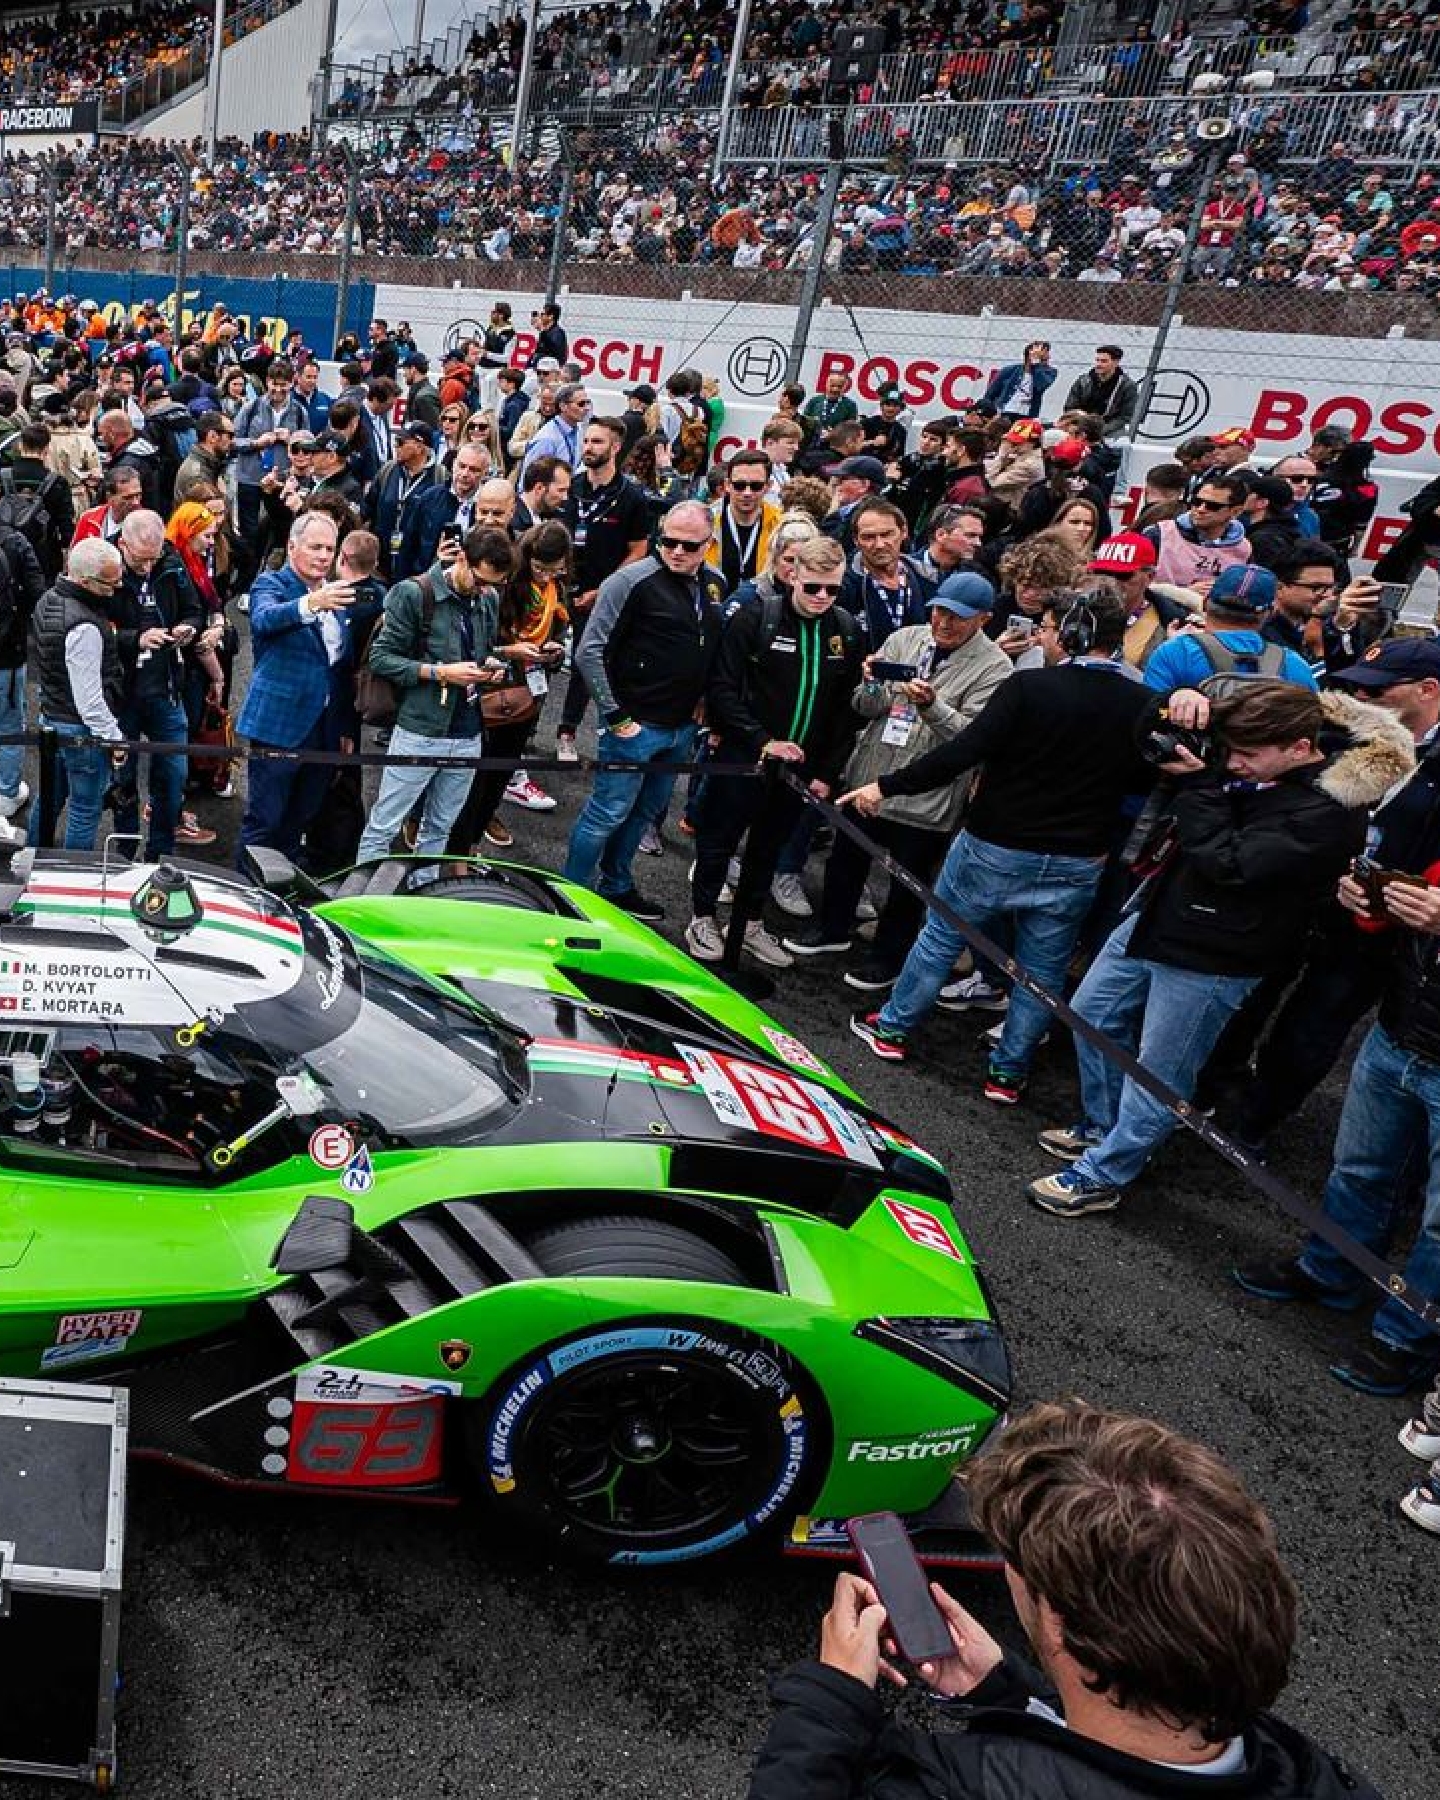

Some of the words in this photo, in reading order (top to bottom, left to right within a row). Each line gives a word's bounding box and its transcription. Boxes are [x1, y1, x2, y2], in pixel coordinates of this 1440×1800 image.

[1, 108, 72, 129] RACEBORN
[510, 333, 665, 384] BSCH
[815, 352, 1000, 412] BOSC
[1251, 390, 1440, 455] BOS
[24, 962, 41, 976] M.
[47, 963, 151, 982] BORTOLOTTI
[22, 979, 38, 992] D.
[42, 981, 97, 996] KVYAT
[21, 997, 36, 1012] E.
[42, 998, 125, 1016] MORTARA
[323, 1138, 341, 1159] E
[349, 1171, 366, 1189] N
[63, 1312, 136, 1331] HYPER
[558, 1345, 591, 1366] PILOT
[592, 1336, 633, 1352] SPORT
[666, 1333, 693, 1348] W
[492, 1370, 544, 1461] MICHELIN
[298, 1407, 437, 1474] 63
[846, 1435, 972, 1463] Fastron
[755, 1435, 804, 1522] MICHELIN
